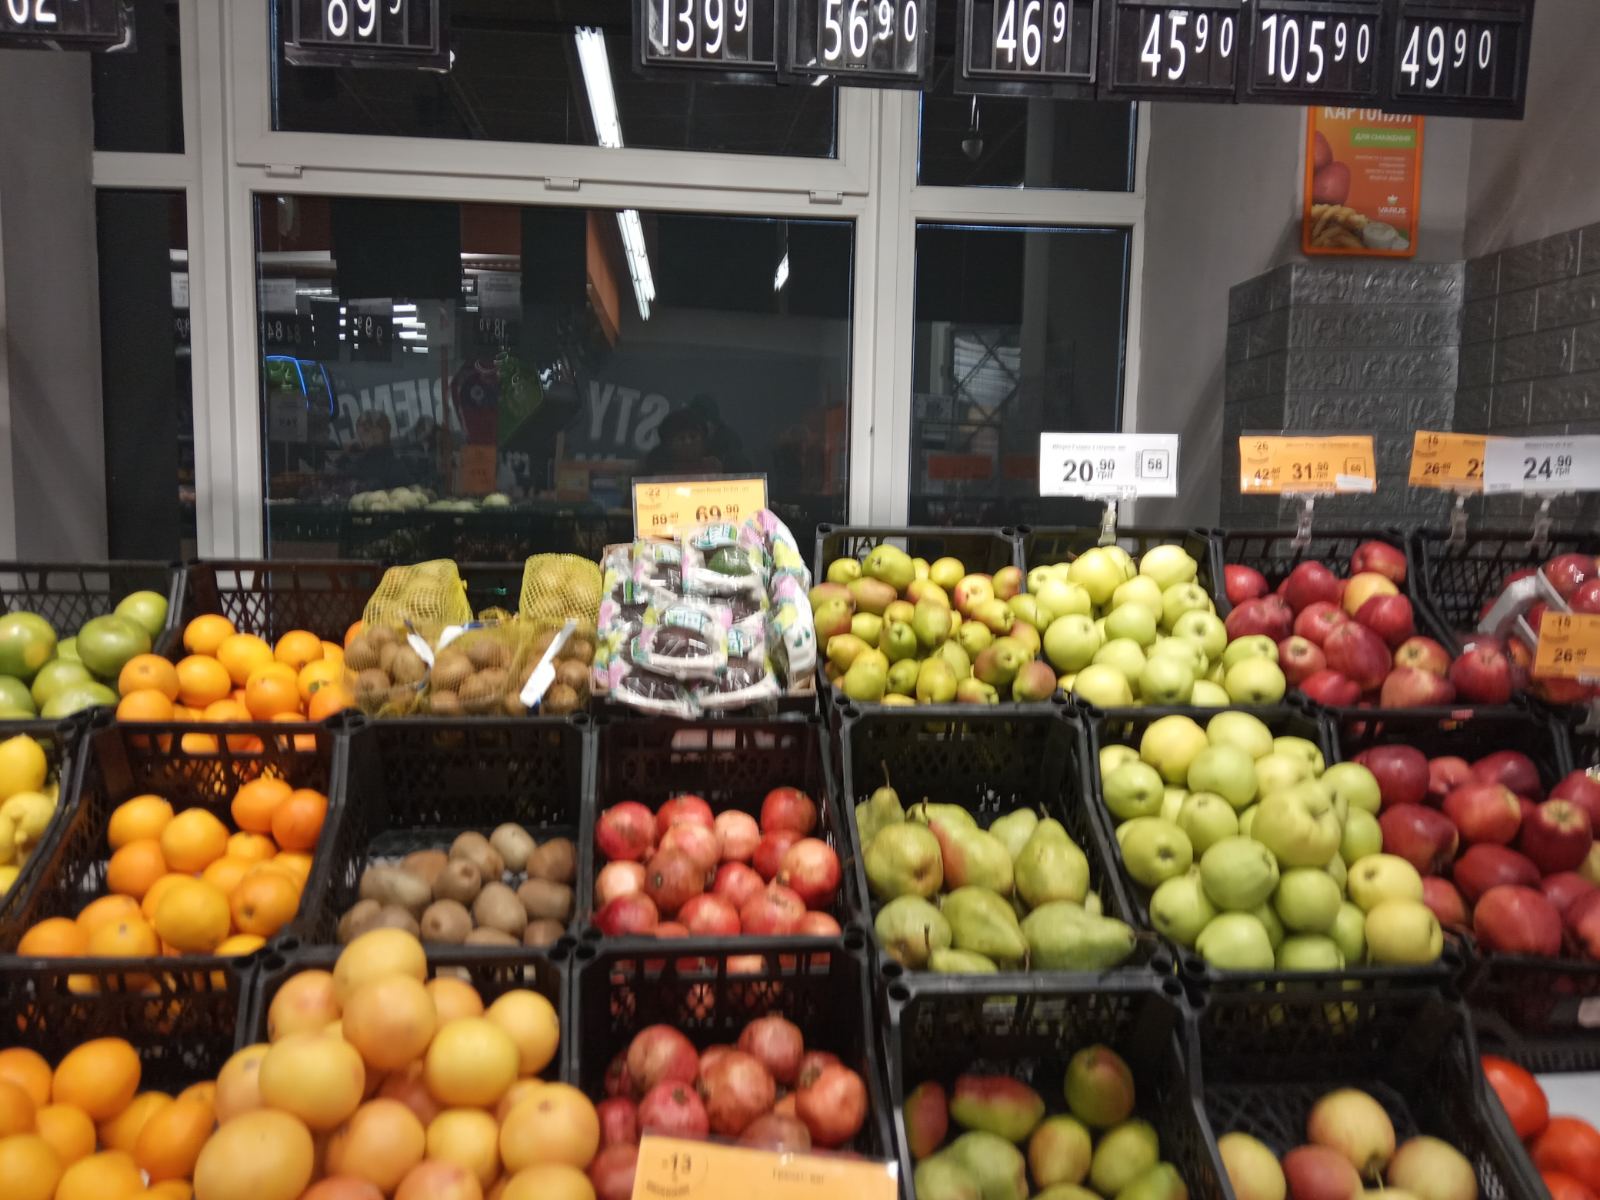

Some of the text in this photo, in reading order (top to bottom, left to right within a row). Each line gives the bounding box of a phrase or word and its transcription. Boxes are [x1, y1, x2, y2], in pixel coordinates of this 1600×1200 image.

[824, 0, 868, 61] 56
[996, 0, 1042, 66] 46
[1141, 13, 1187, 80] 45
[1261, 13, 1326, 84] 105
[1400, 25, 1445, 88] 49
[1062, 459, 1093, 482] 20
[1292, 462, 1312, 480] 31
[1523, 456, 1552, 480] 24
